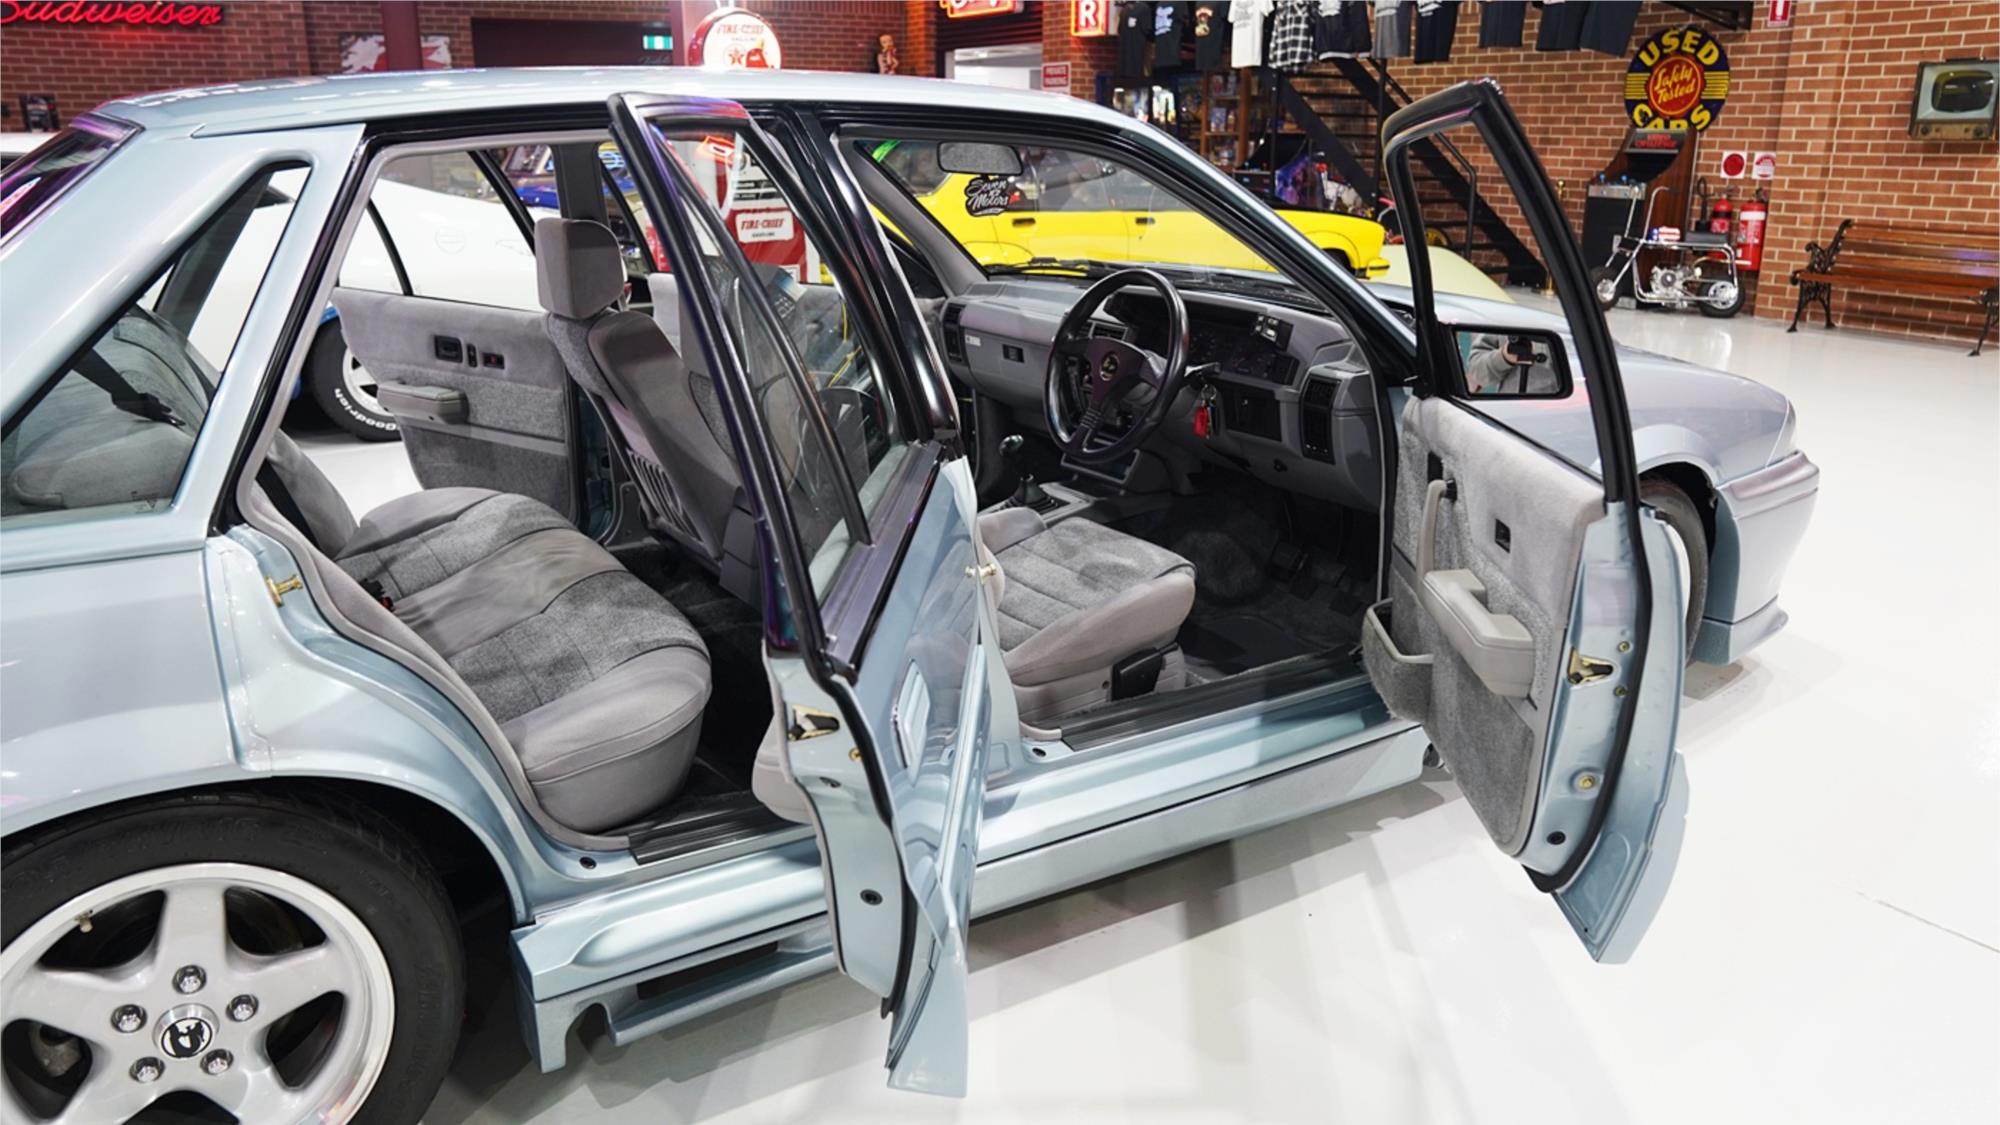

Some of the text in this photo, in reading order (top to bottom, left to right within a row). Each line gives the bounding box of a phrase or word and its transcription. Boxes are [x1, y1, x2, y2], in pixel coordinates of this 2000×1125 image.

[1638, 30, 1720, 66] USED
[1654, 64, 1694, 91] Safety
[1657, 79, 1696, 104] Tested
[967, 193, 1009, 210] Motors
[334, 388, 400, 431] Goodrich
